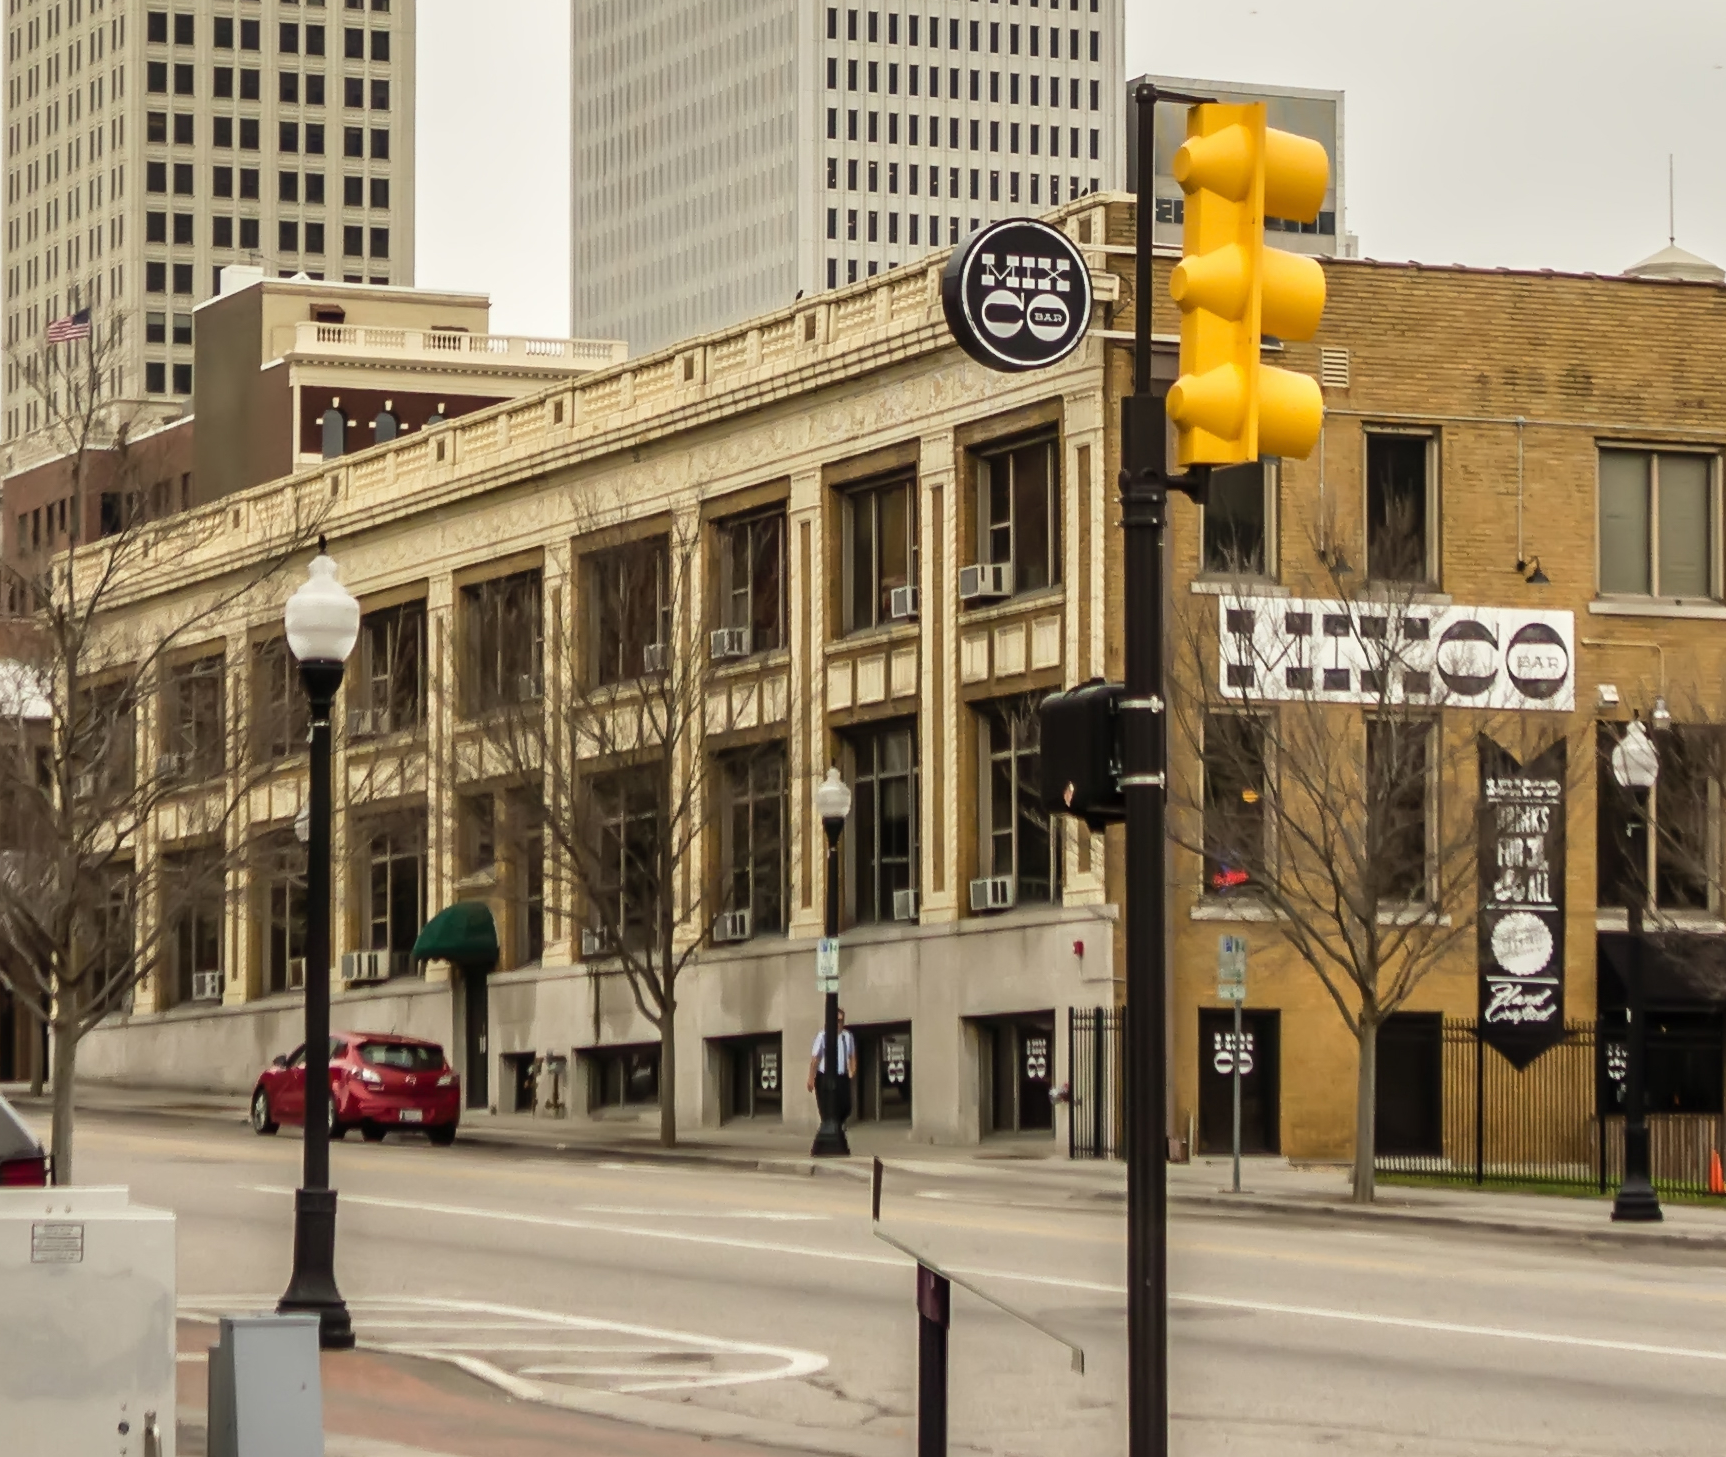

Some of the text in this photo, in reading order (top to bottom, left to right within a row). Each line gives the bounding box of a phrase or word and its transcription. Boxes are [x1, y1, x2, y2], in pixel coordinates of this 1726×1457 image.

[981, 253, 1070, 292] MIX
[1034, 312, 1063, 323] BAR
[1517, 654, 1560, 671] BAR
[1528, 871, 1552, 902] ALL
